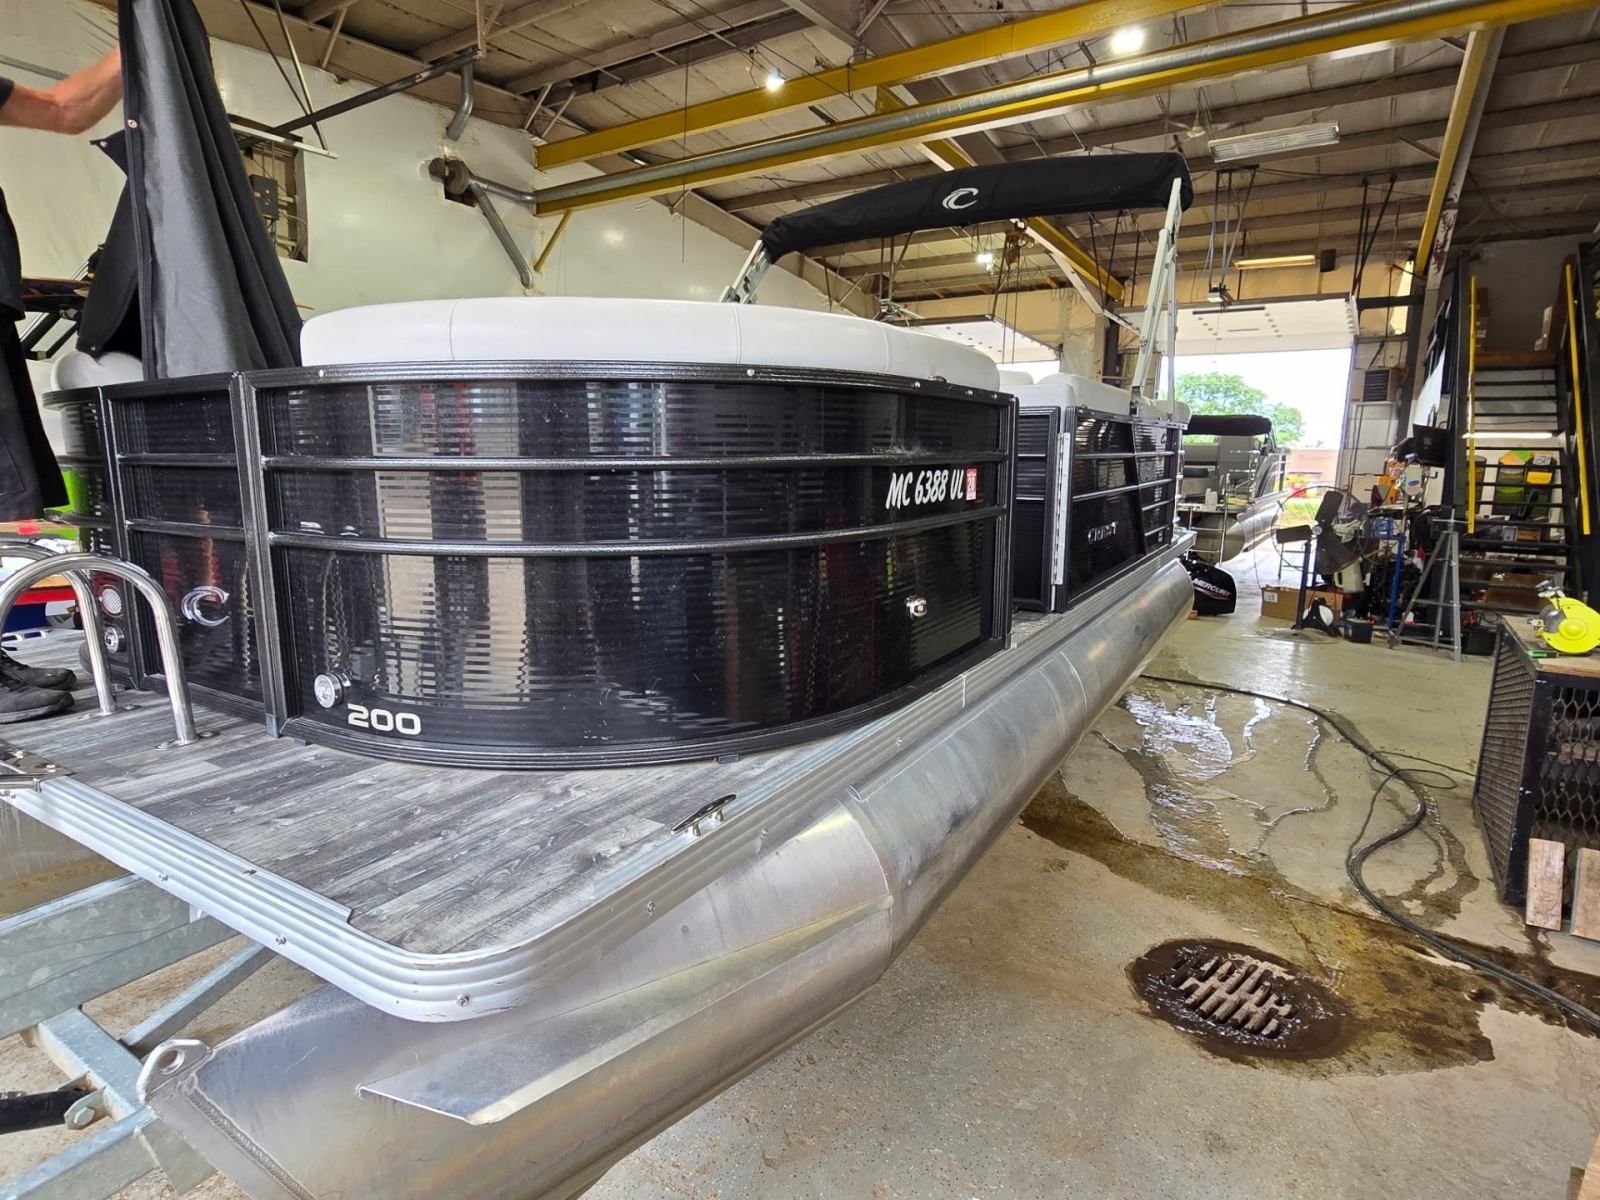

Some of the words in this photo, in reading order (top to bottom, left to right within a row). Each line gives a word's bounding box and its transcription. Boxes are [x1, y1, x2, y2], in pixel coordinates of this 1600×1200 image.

[885, 471, 913, 510] MC
[915, 468, 949, 505] 6388
[950, 469, 964, 500] UL
[1192, 578, 1231, 597] MERCURY
[347, 703, 421, 735] 200
